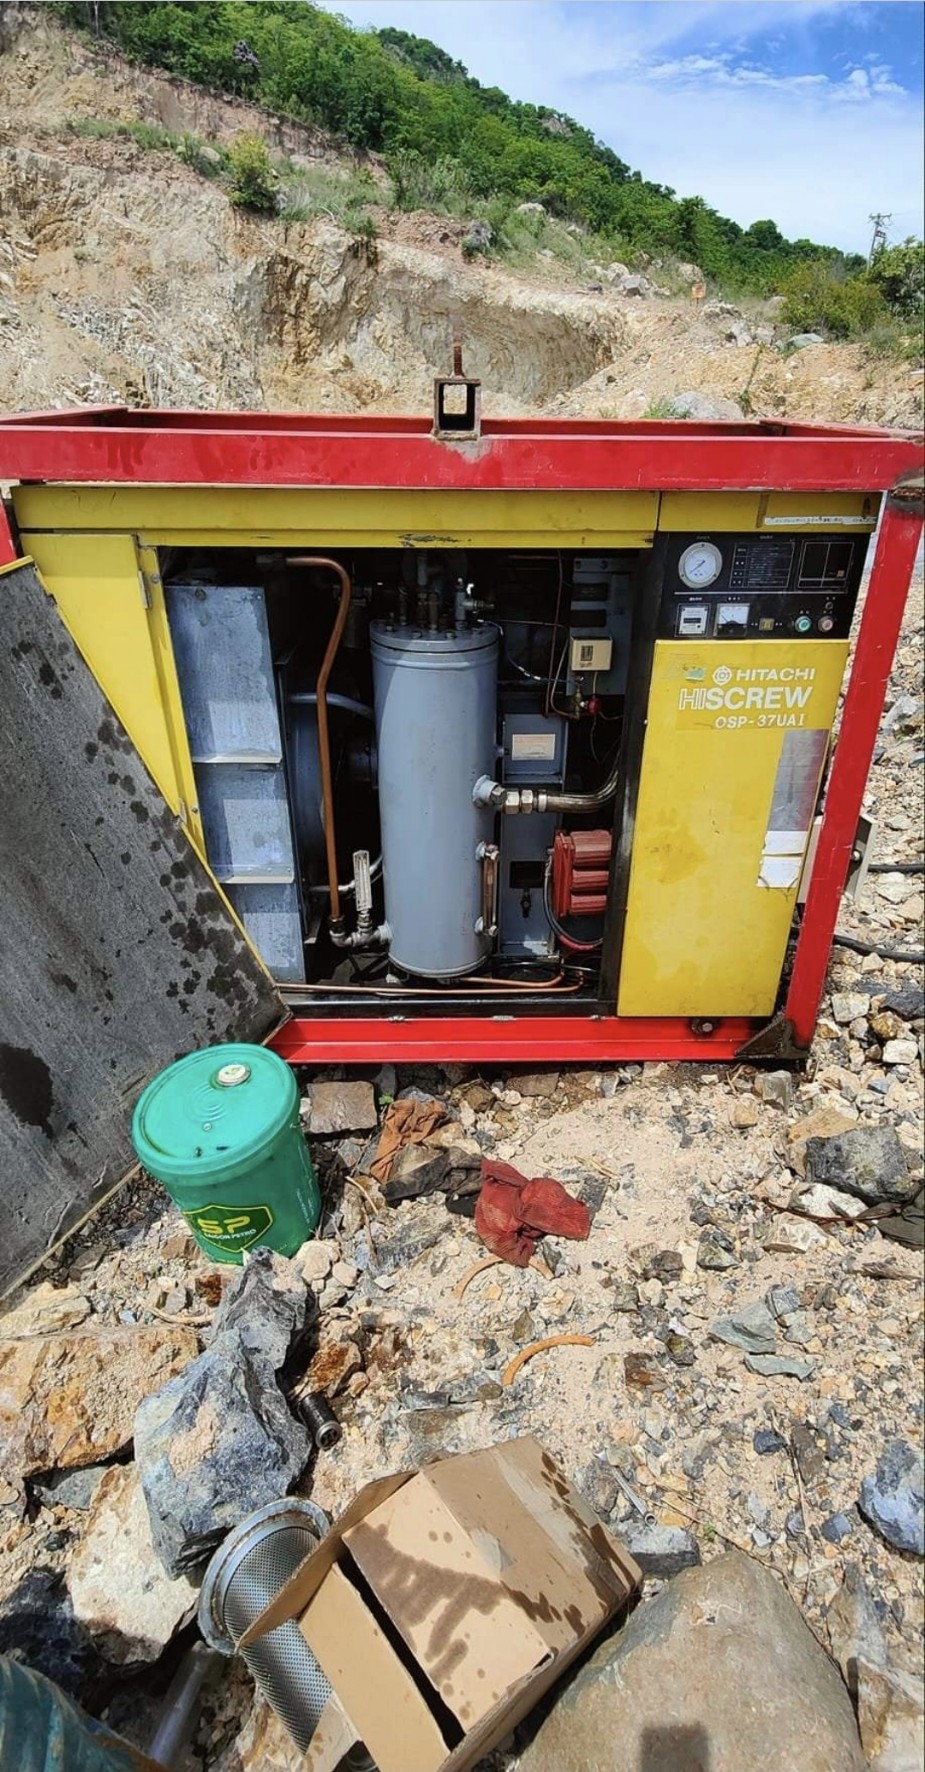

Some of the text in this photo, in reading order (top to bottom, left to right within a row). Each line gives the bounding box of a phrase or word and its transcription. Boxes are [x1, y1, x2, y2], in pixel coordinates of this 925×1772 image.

[736, 667, 816, 681] HITACHI
[679, 686, 813, 711] HISCREW
[198, 1215, 250, 1234] SP
